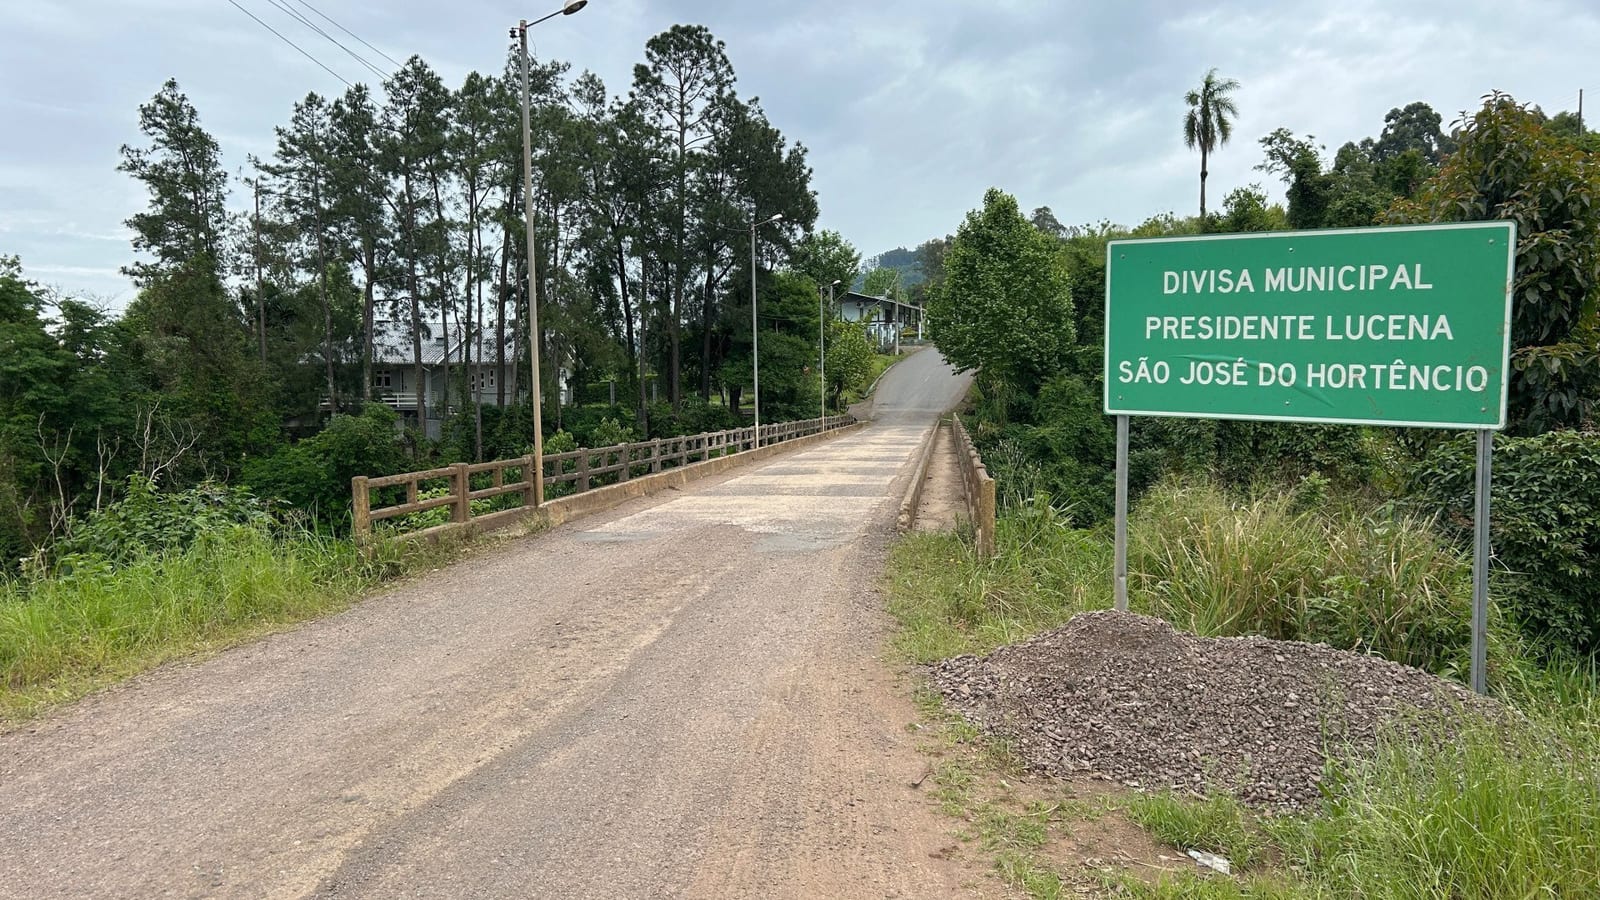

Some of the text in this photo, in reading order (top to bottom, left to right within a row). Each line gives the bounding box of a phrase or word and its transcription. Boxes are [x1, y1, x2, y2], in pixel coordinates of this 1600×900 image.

[1163, 263, 1433, 294] DIVISA MUNICIPAL
[1145, 314, 1454, 341] PRESIDENTE LUCENA
[1118, 356, 1488, 392] SÃO JOSÉ DO HORTÊNCIO
